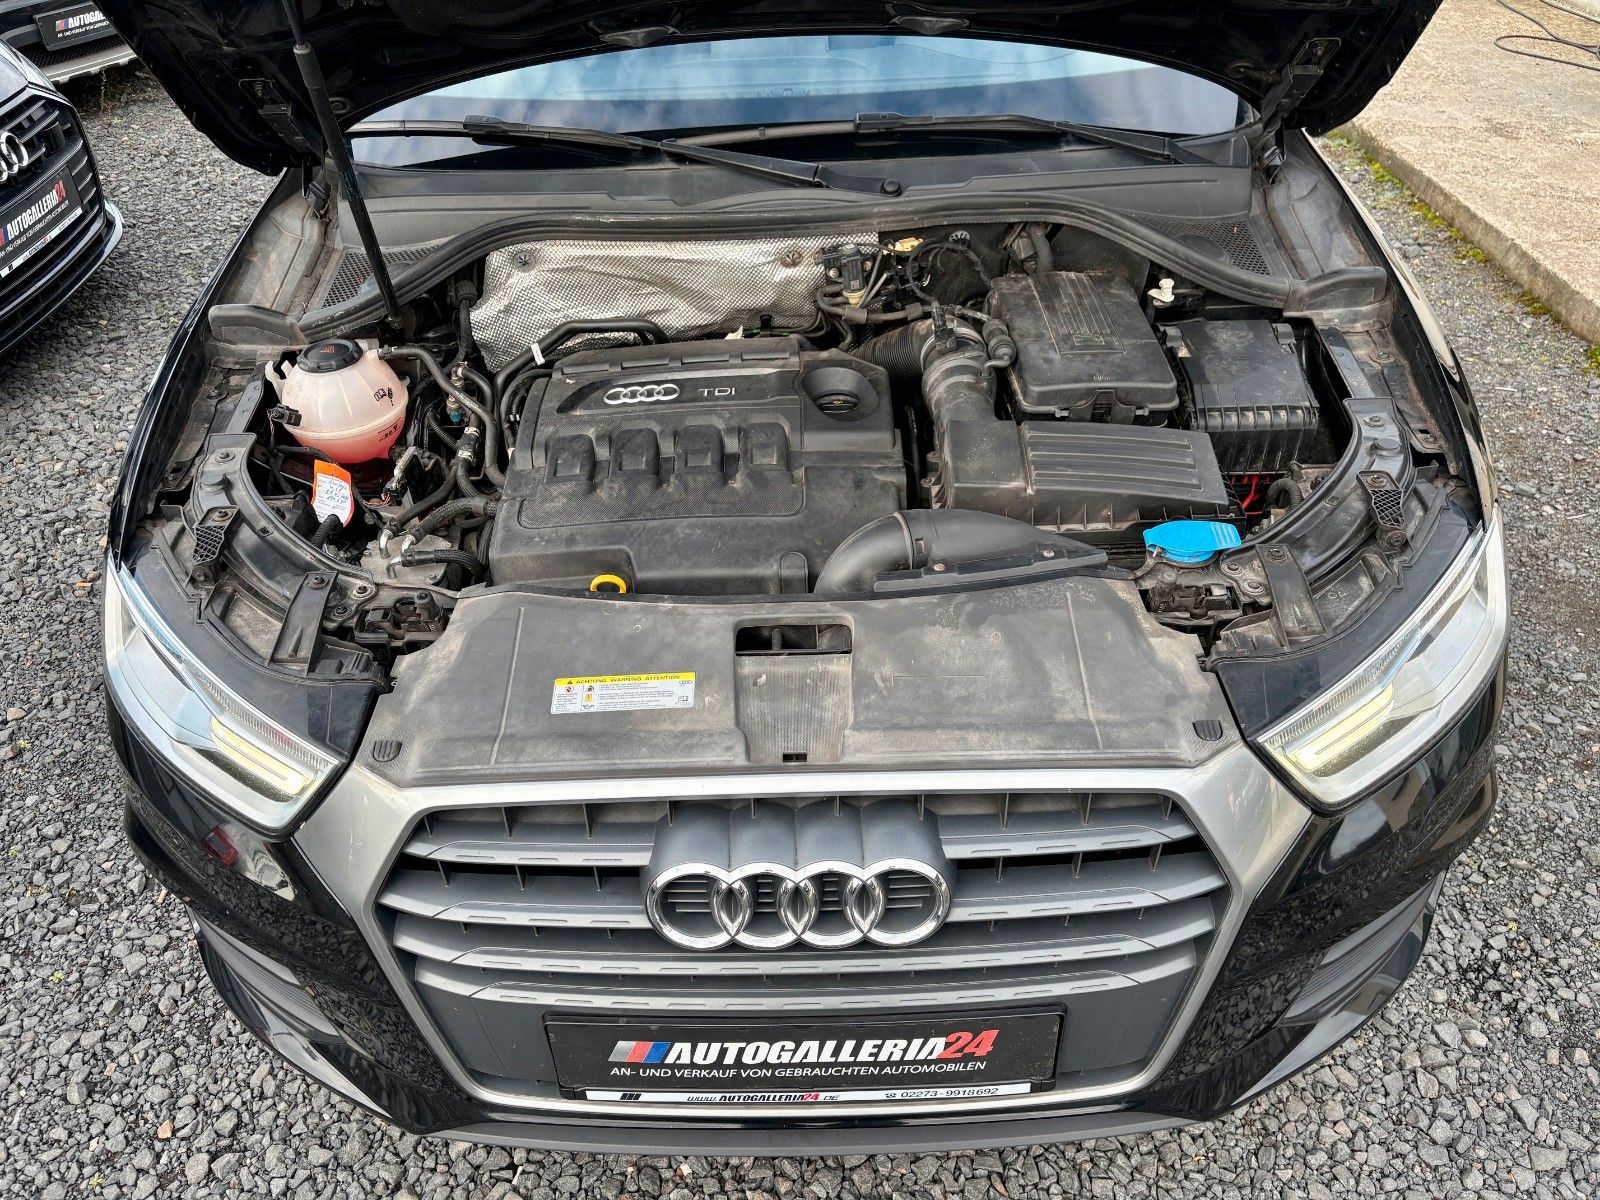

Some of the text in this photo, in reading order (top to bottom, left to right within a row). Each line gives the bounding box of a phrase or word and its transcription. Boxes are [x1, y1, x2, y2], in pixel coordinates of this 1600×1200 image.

[7, 180, 65, 240] AUTOGALLERIA24
[698, 387, 736, 397] TDI
[664, 1029, 1000, 1065] AUTOGALLERIA24
[610, 1060, 986, 1078] AN- UND VERKAUF VON GEBRAUCHTEN AUTOMOBILEN
